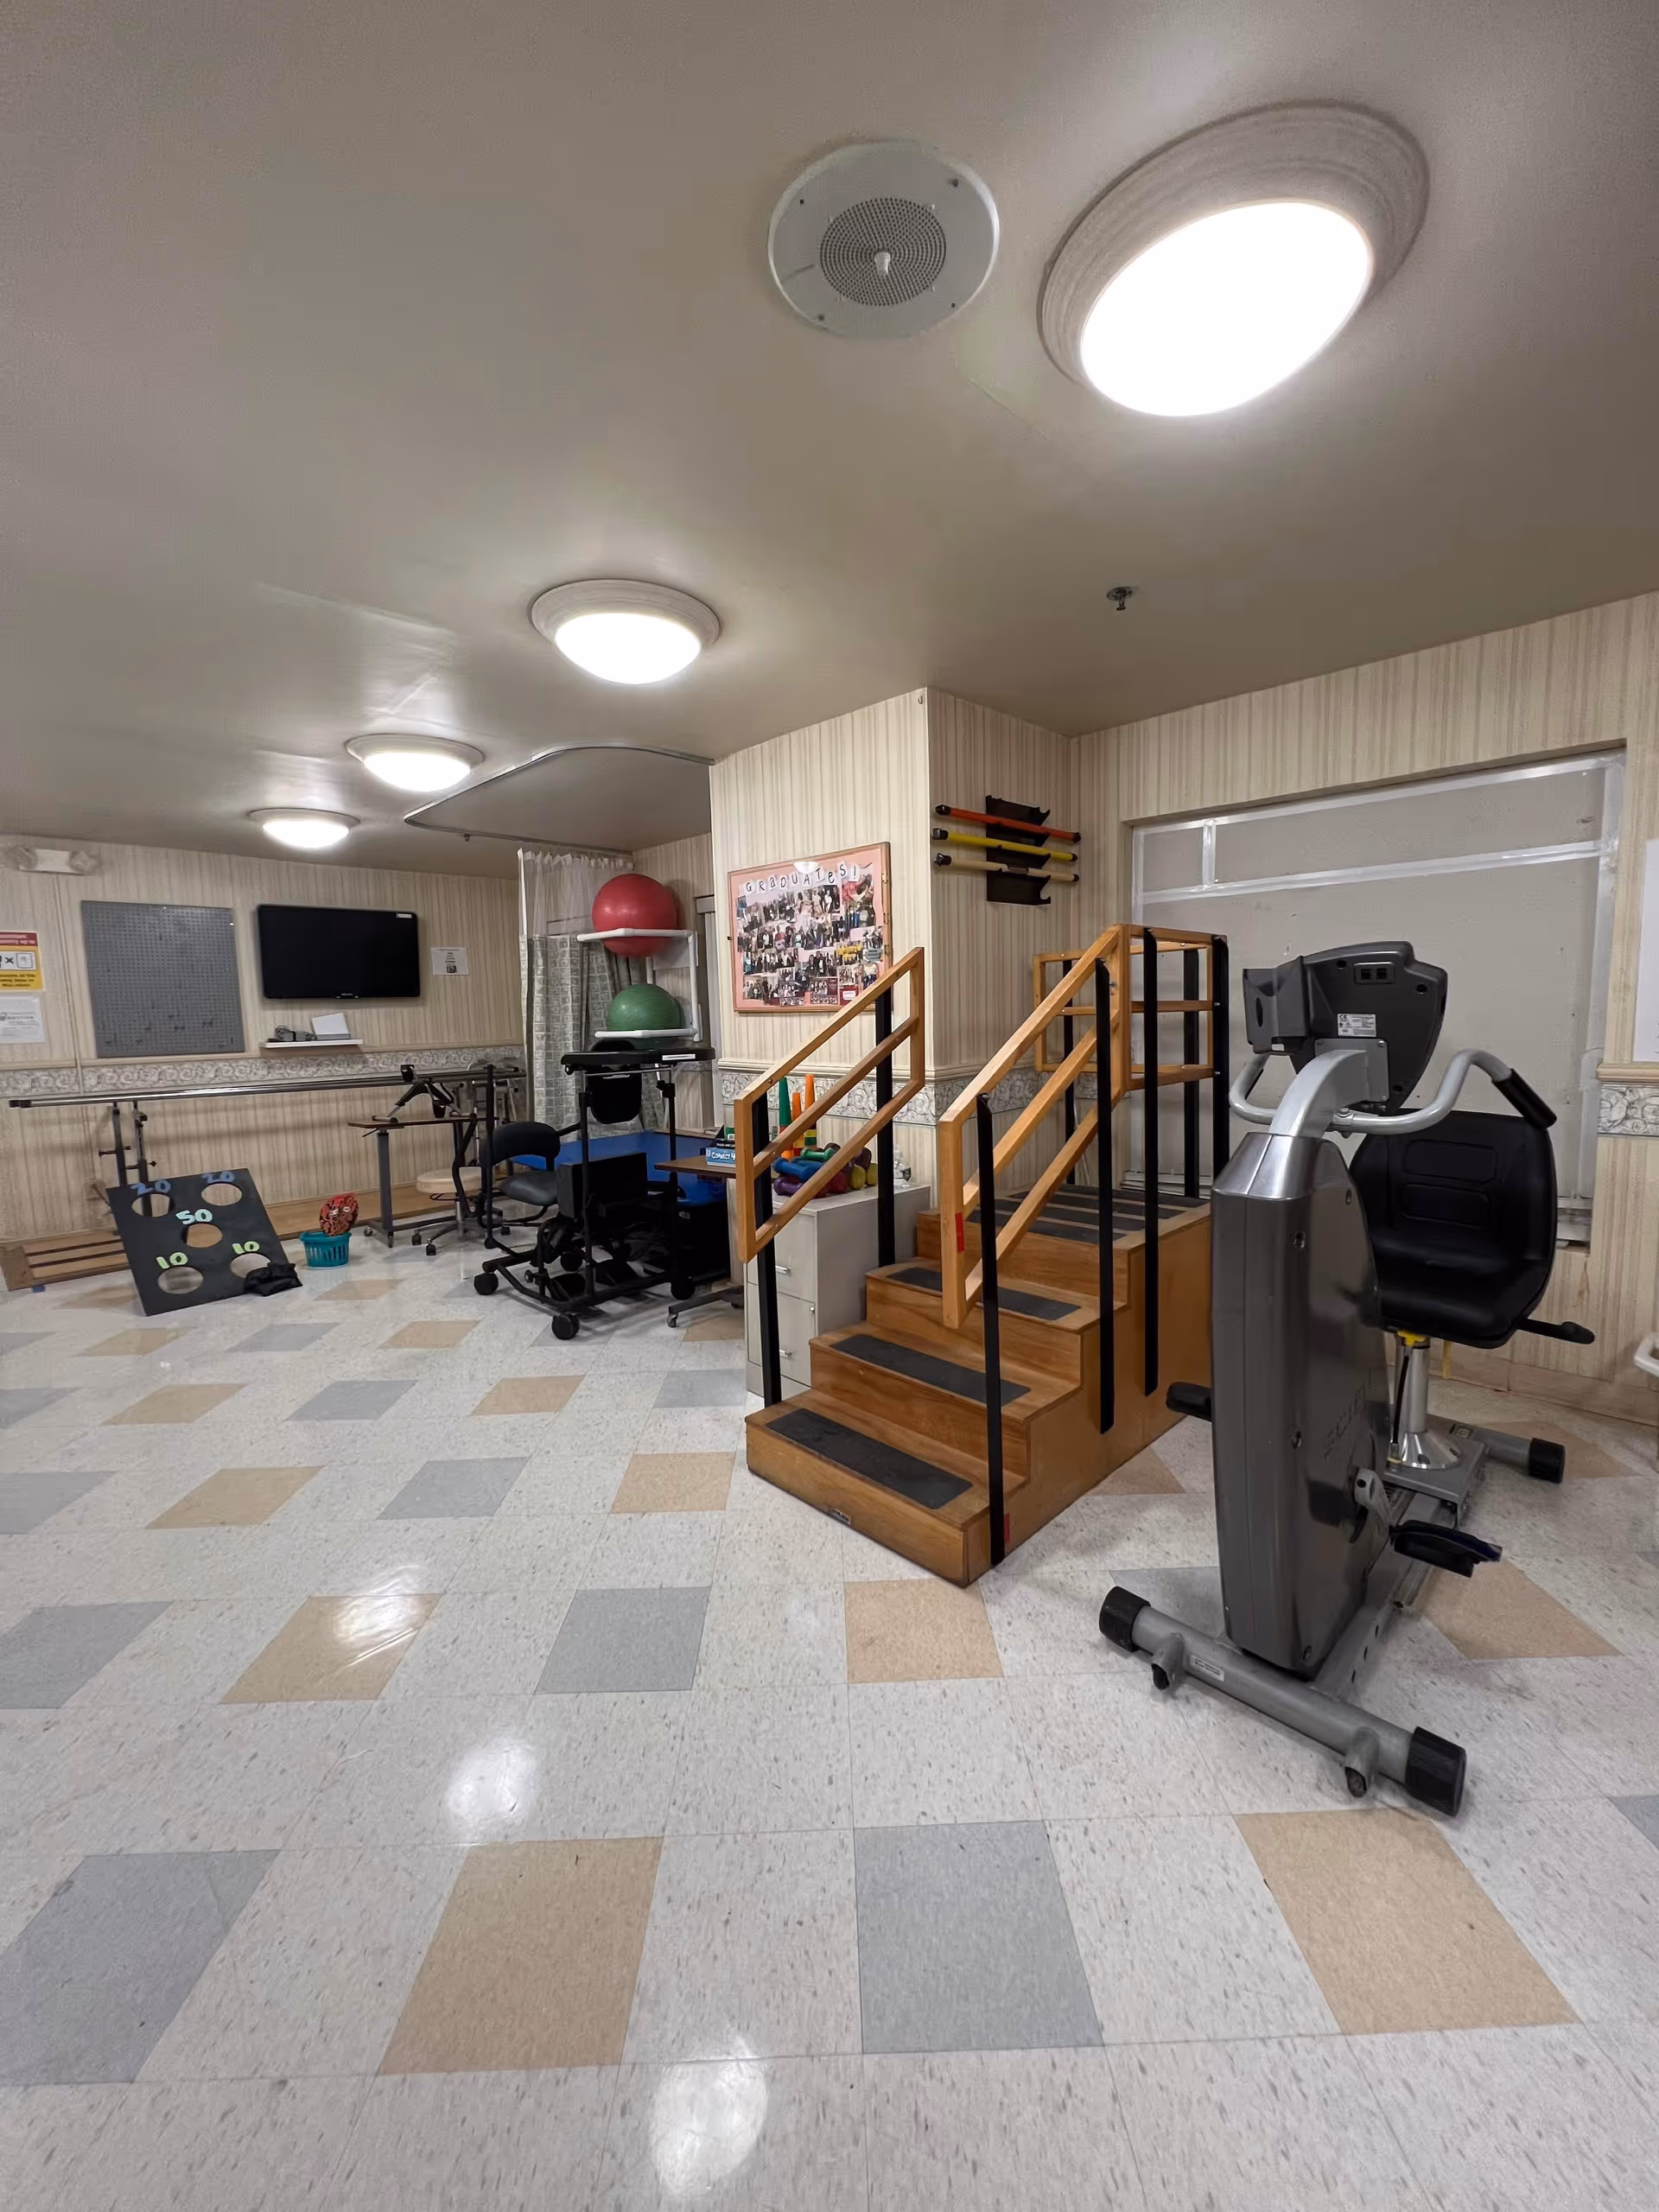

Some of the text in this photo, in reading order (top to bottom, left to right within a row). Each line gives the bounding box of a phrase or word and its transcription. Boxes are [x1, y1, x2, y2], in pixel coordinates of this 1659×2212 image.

[201, 1171, 235, 1184] 20
[130, 1179, 171, 1195] 20
[175, 1209, 213, 1225] 50
[232, 1241, 260, 1255] 10
[156, 1251, 188, 1269] 10
